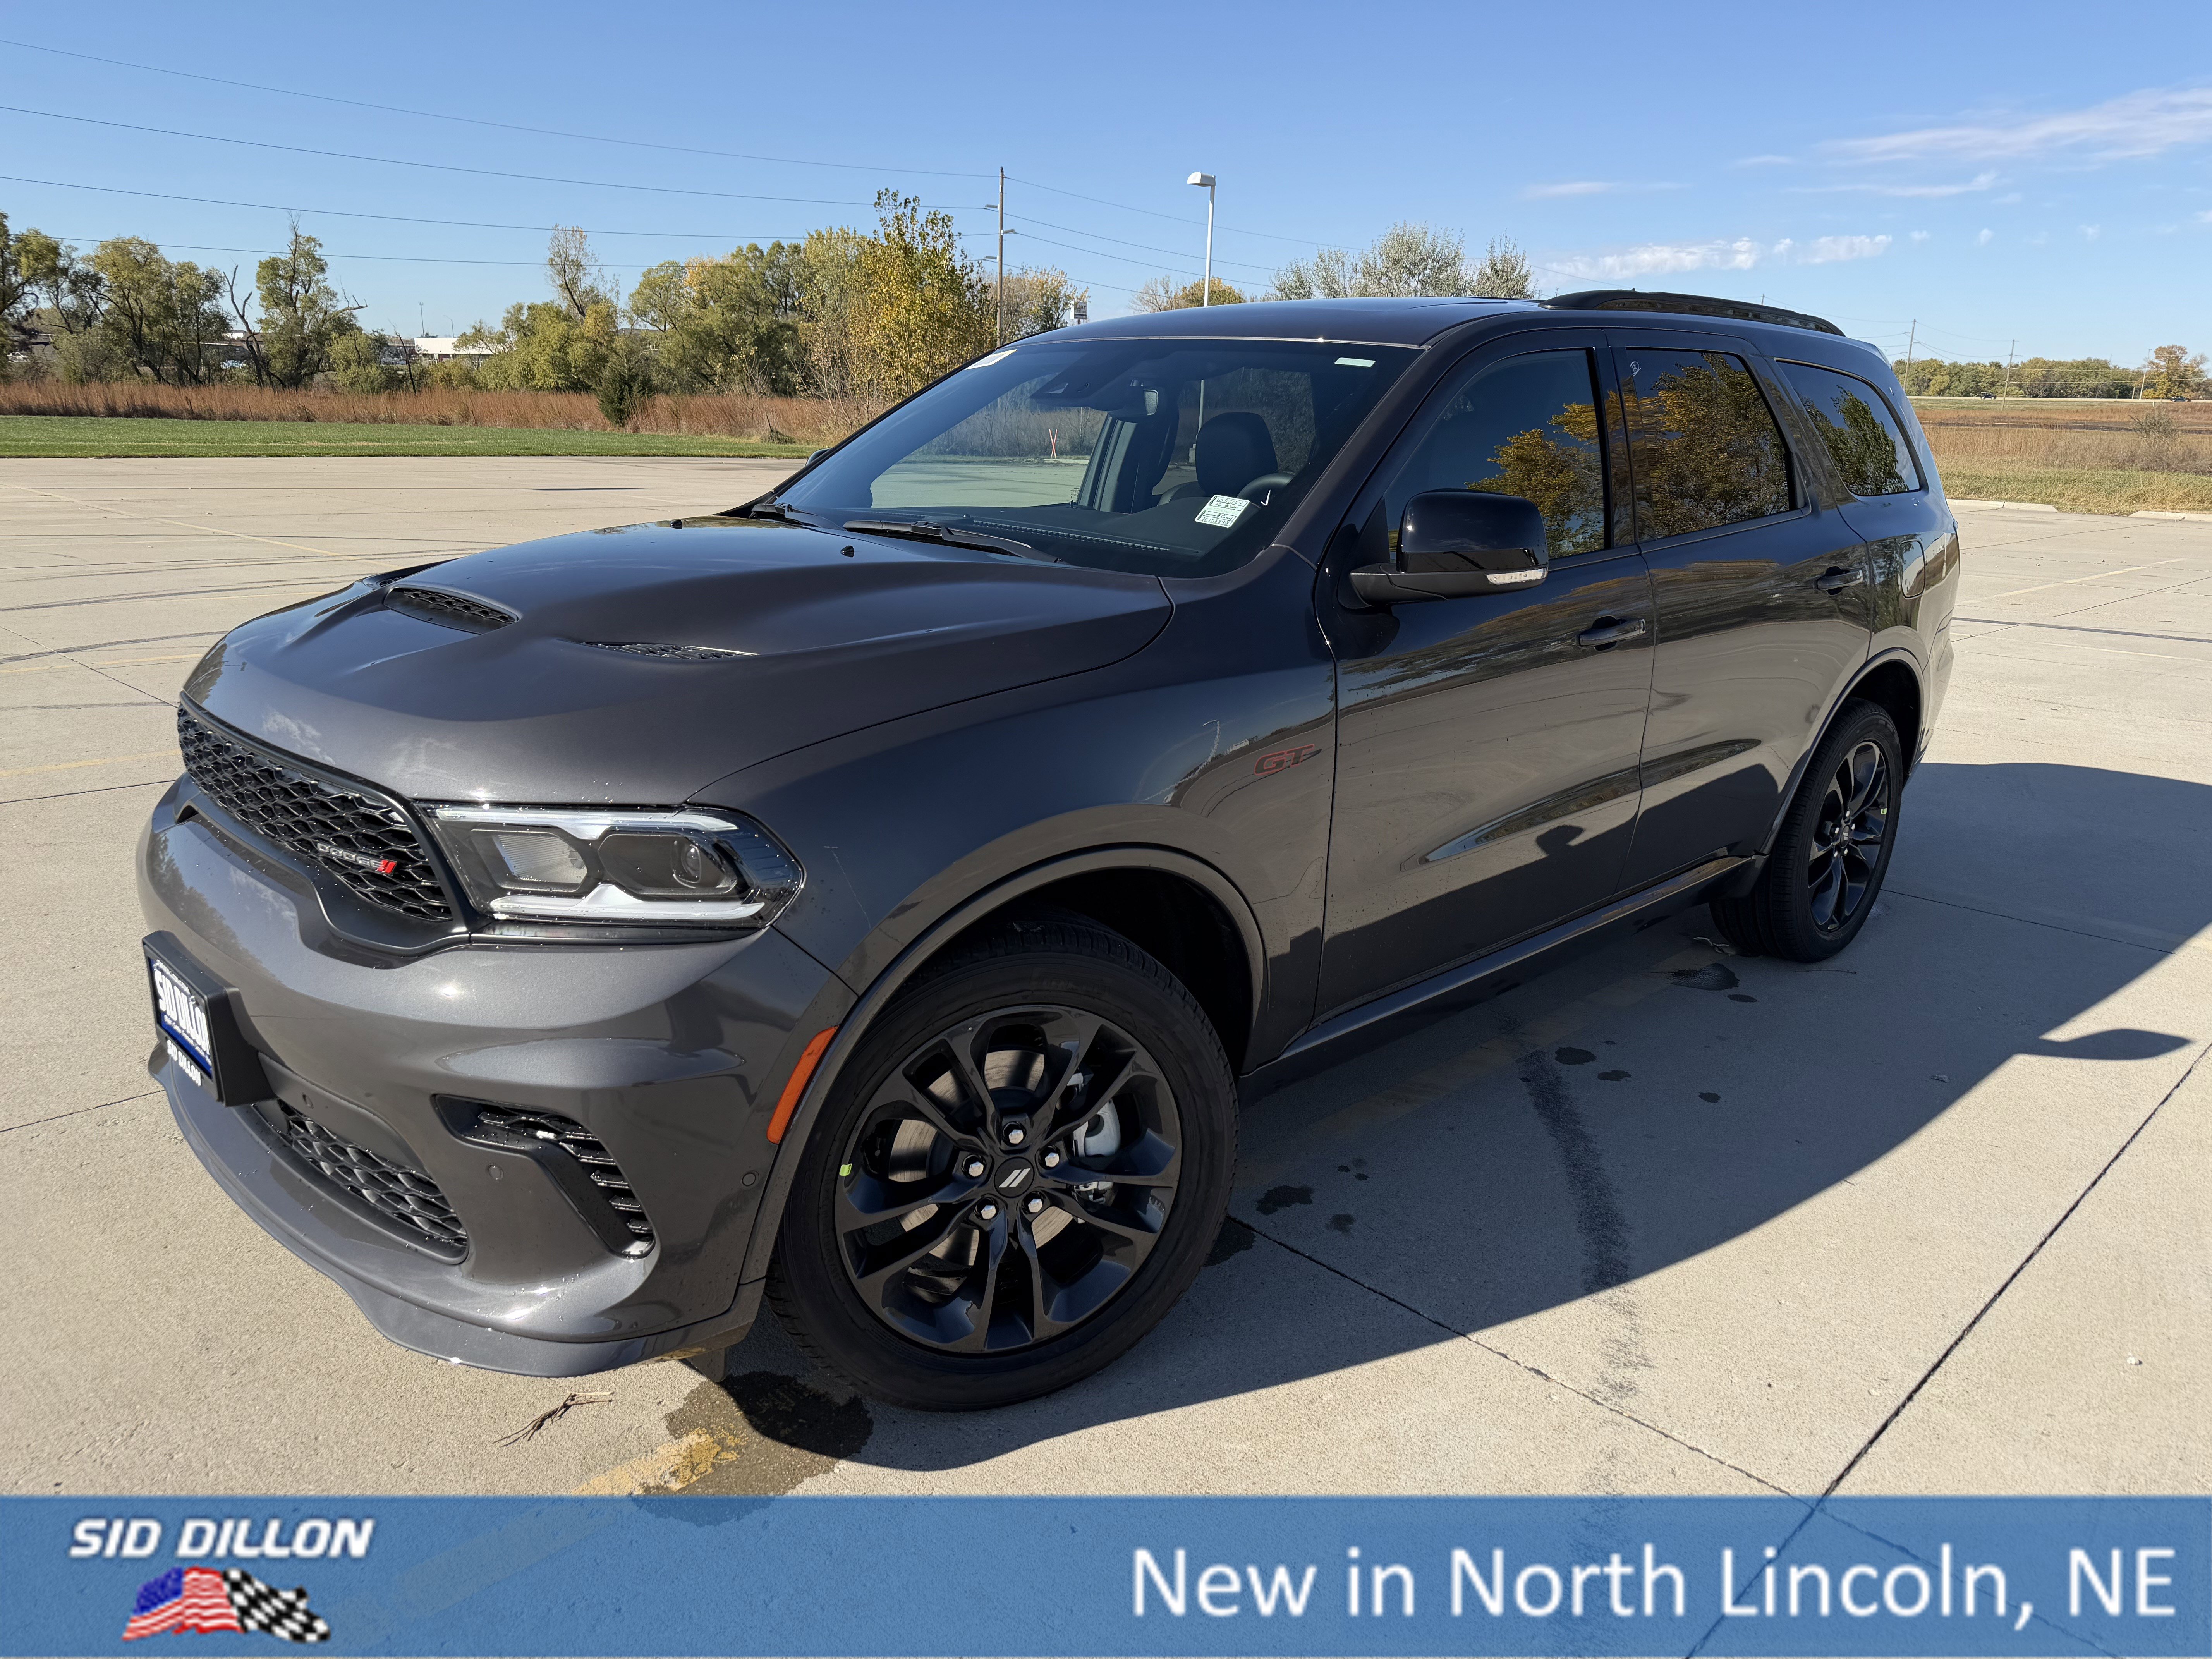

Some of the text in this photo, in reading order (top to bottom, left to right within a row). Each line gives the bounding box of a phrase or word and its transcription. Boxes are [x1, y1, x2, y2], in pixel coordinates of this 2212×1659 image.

[1254, 743, 1315, 776] GT
[317, 843, 385, 870] DODGE
[155, 970, 177, 1021] SID
[173, 986, 210, 1056] DILLON
[167, 1039, 201, 1087] SID DILLON
